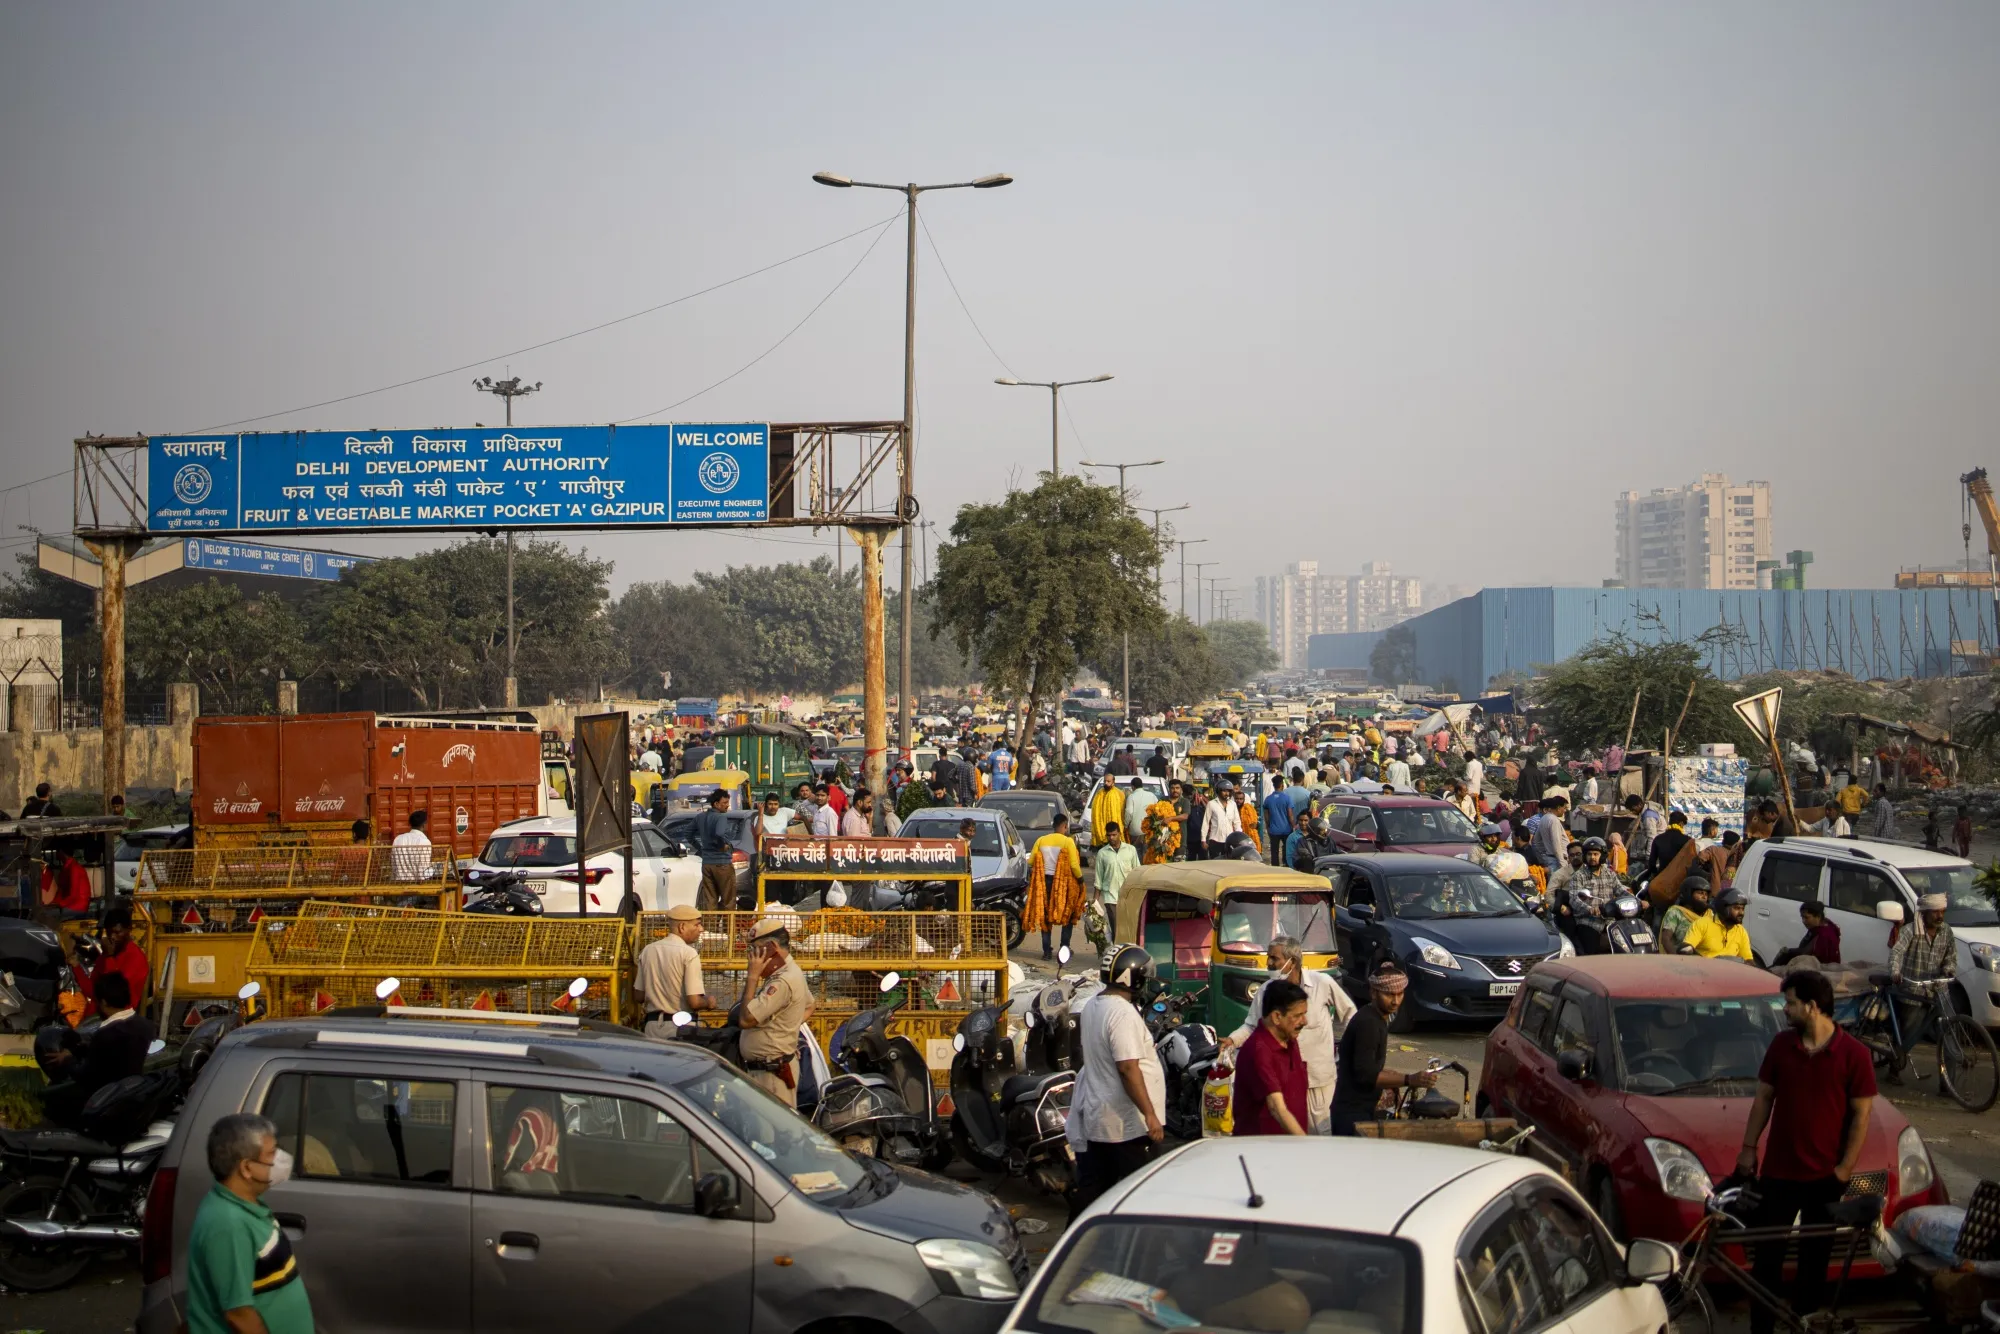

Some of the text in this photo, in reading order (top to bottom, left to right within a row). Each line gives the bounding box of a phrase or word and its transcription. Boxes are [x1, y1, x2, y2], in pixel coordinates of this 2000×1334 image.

[344, 434, 563, 455] दिल्ली विकास प्राधिकरण
[676, 432, 764, 446] WELCOME
[162, 441, 227, 460] स्वागतम्
[296, 457, 610, 476] DELHI DEVELOPMENT AUTHORITY
[282, 485, 315, 499] फल
[325, 482, 349, 501] एवं
[359, 479, 404, 498] सब्जी
[413, 478, 448, 497] मंडी
[456, 478, 505, 496] पाकेट
[559, 475, 626, 499] गाजीपुर
[244, 502, 665, 522] FRUIT & VEGETABLE MARKET POCKET 'A' GAZIPUR
[723, 499, 763, 507] ENGINEER
[204, 544, 300, 564] WELCOME TO FLOWER TRADE CENTRE
[771, 842, 800, 866] पुलिस
[1208, 1242, 1234, 1260] P
